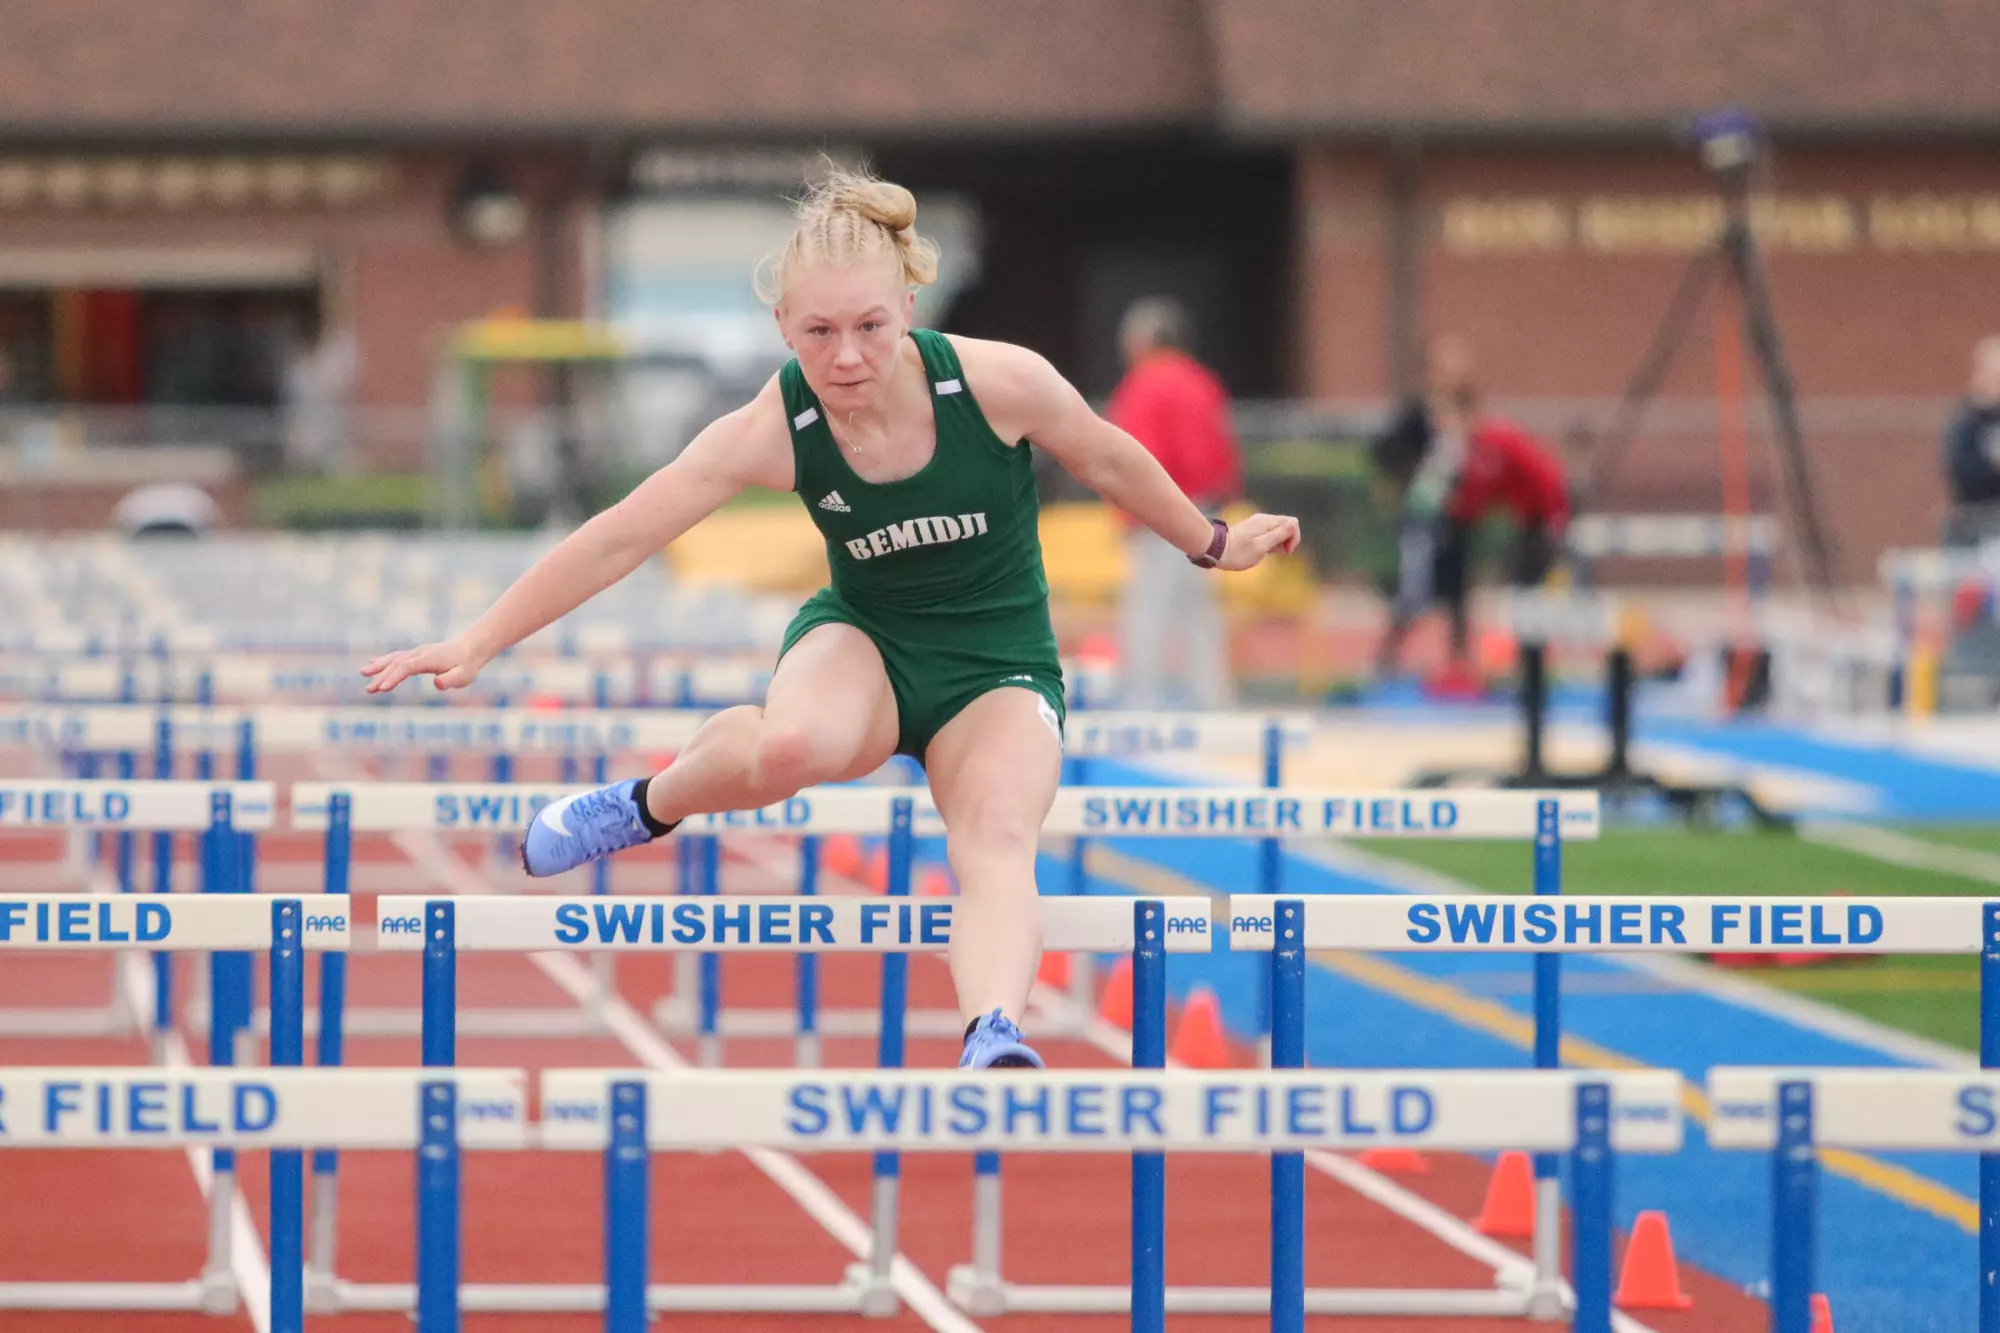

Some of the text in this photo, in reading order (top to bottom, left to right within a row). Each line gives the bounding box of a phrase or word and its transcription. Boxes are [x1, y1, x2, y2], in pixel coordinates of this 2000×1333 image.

[819, 502, 851, 512] adidas
[845, 512, 988, 560] BEMIDJI
[0, 791, 130, 821] FIELD
[1084, 797, 1459, 829] SWISHER FIELD
[0, 902, 172, 941] FIELD
[555, 903, 953, 944] SWISHER FIE
[1406, 903, 1884, 945] SWISHER FIELD
[44, 1082, 279, 1133] FIELD
[787, 1083, 1437, 1137] SWISHER FIELD
